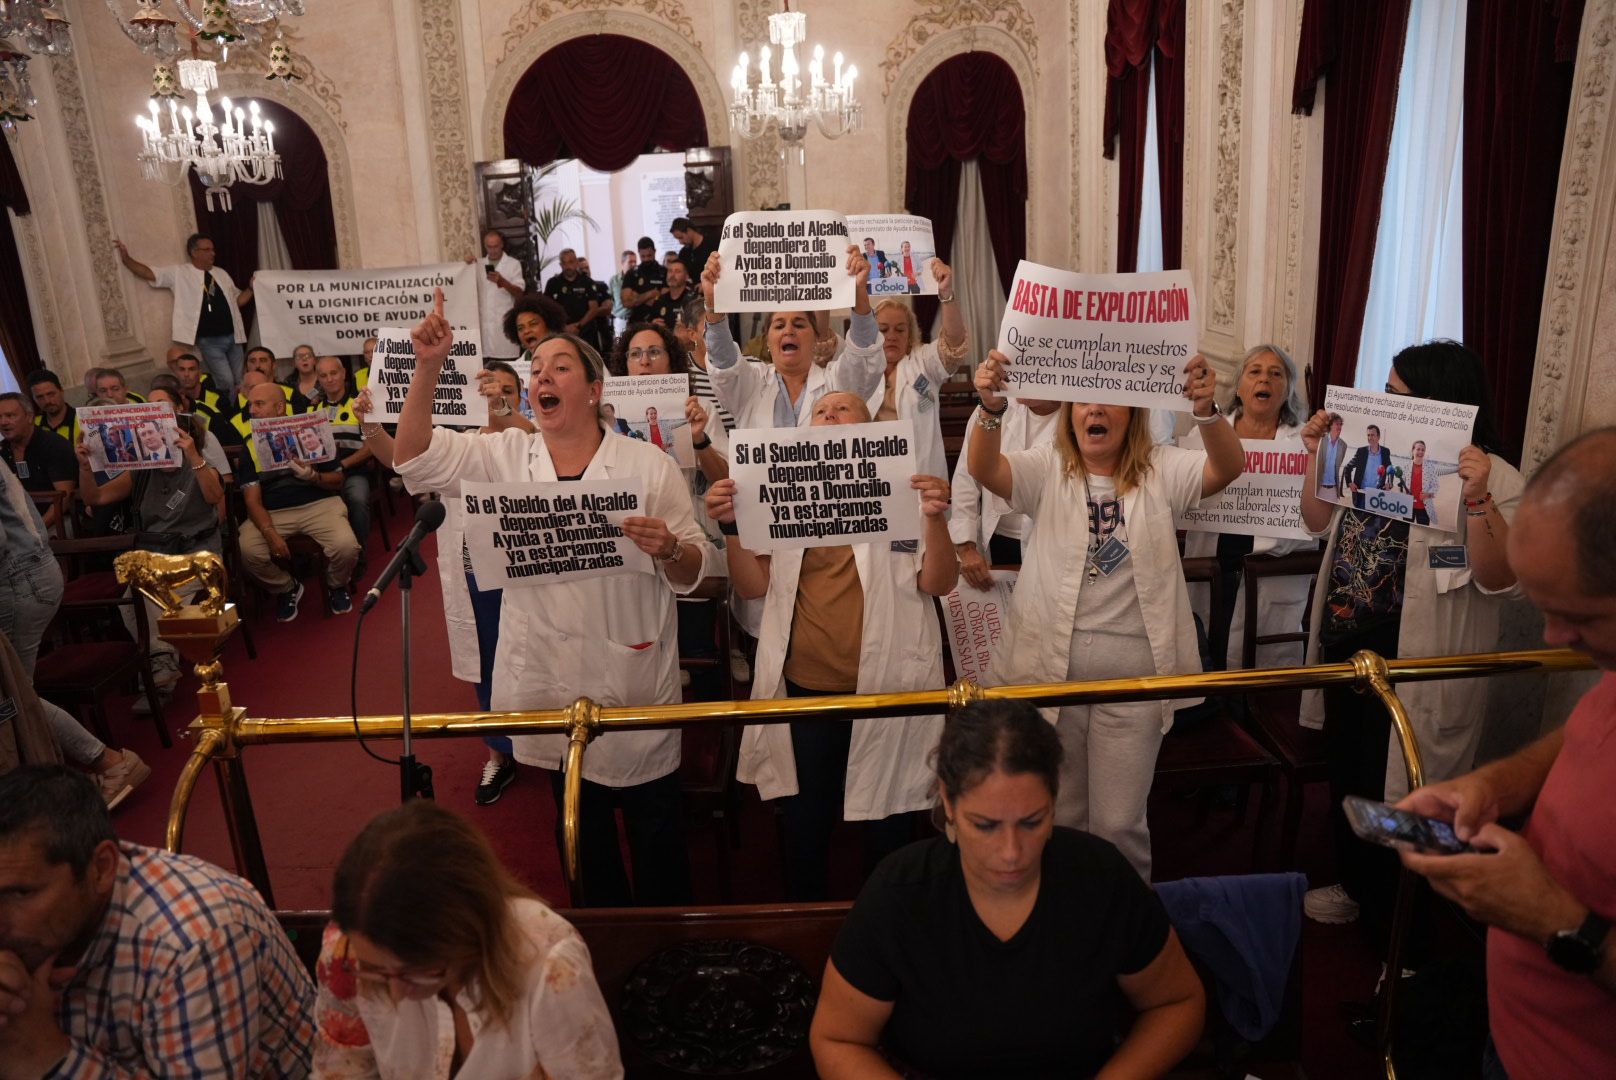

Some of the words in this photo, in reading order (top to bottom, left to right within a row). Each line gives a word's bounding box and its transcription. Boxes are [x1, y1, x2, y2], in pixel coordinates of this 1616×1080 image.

[733, 223, 743, 238] el
[747, 222, 783, 238] Sueldo
[788, 221, 805, 237] del
[808, 221, 848, 238] Alcalde
[744, 237, 809, 256] dependiera
[813, 237, 826, 252] de
[735, 254, 772, 271] Ayuda
[775, 257, 781, 269] a
[785, 254, 836, 269] Domicilio
[277, 283, 305, 293] POR
[309, 282, 325, 292] LA
[330, 273, 454, 292] MUNICIPALIZACIÓN
[743, 272, 758, 288] ya
[287, 300, 294, 309] Y
[299, 299, 313, 309] LA
[319, 291, 418, 307] DIGNIFICACIÓN
[740, 285, 832, 304] municipalizadas
[1012, 279, 1058, 319] BASTA
[1063, 289, 1084, 320] DE
[1086, 283, 1189, 323] EXPLOTACIÓN
[299, 314, 359, 324] SERVICIO
[364, 312, 380, 322] DE
[385, 310, 426, 320] AYUDA
[1007, 327, 1035, 352] Que
[1039, 337, 1053, 349] se
[1057, 334, 1121, 356] cumplan
[1126, 340, 1187, 357] nuestros
[1015, 347, 1078, 370] derechos
[1082, 355, 1145, 374] laborales
[1147, 364, 1157, 380] y
[1160, 363, 1175, 376] se
[379, 369, 410, 386] Ayuda
[1062, 373, 1121, 391] nuestros
[386, 387, 400, 400] ya
[636, 388, 653, 396] Ayuda
[1328, 389, 1333, 397] El
[1334, 391, 1374, 405] Ayuntamiento
[1375, 394, 1406, 409] rechazará
[1406, 401, 1413, 409] la
[1413, 404, 1441, 416] petición
[1442, 407, 1451, 416] de
[1452, 407, 1473, 419] Óbolo
[1326, 401, 1333, 409] de
[1334, 401, 1362, 413] resolución
[1363, 407, 1371, 415] de
[1372, 409, 1397, 420] contrato
[1398, 413, 1407, 421] de
[1408, 414, 1429, 427] Ayuda
[1436, 418, 1468, 431] Domicilio
[736, 444, 749, 464] Si
[753, 443, 766, 464] el
[770, 441, 820, 462] Sueldo
[824, 439, 846, 460] del
[852, 435, 908, 459] Alcalde
[768, 462, 854, 485] dependiera
[858, 460, 876, 479] de
[759, 483, 806, 505] Ayuda
[811, 485, 820, 500] a
[824, 479, 891, 500] Domicilio
[1224, 482, 1266, 500] umplan
[465, 494, 479, 514] Si
[483, 496, 496, 514] el
[500, 494, 549, 514] Sueldo
[553, 494, 575, 512] del
[582, 492, 637, 511] Alcalde
[771, 505, 790, 523] ya
[794, 499, 882, 520] estaríamos
[1237, 497, 1280, 513] laborales
[1283, 505, 1289, 514] y
[500, 512, 586, 534] dependiera
[591, 510, 608, 524] de
[769, 516, 888, 538] municipalizadas
[1223, 512, 1265, 525] nuestros
[493, 532, 540, 550] Ayuda
[544, 532, 554, 544] a
[556, 524, 624, 541] Domicilio
[505, 549, 526, 565] ya
[530, 540, 616, 561] estaríamos
[506, 554, 624, 578] municipalizadas
[967, 601, 988, 650] COBRAR
[977, 651, 990, 673] BIE
